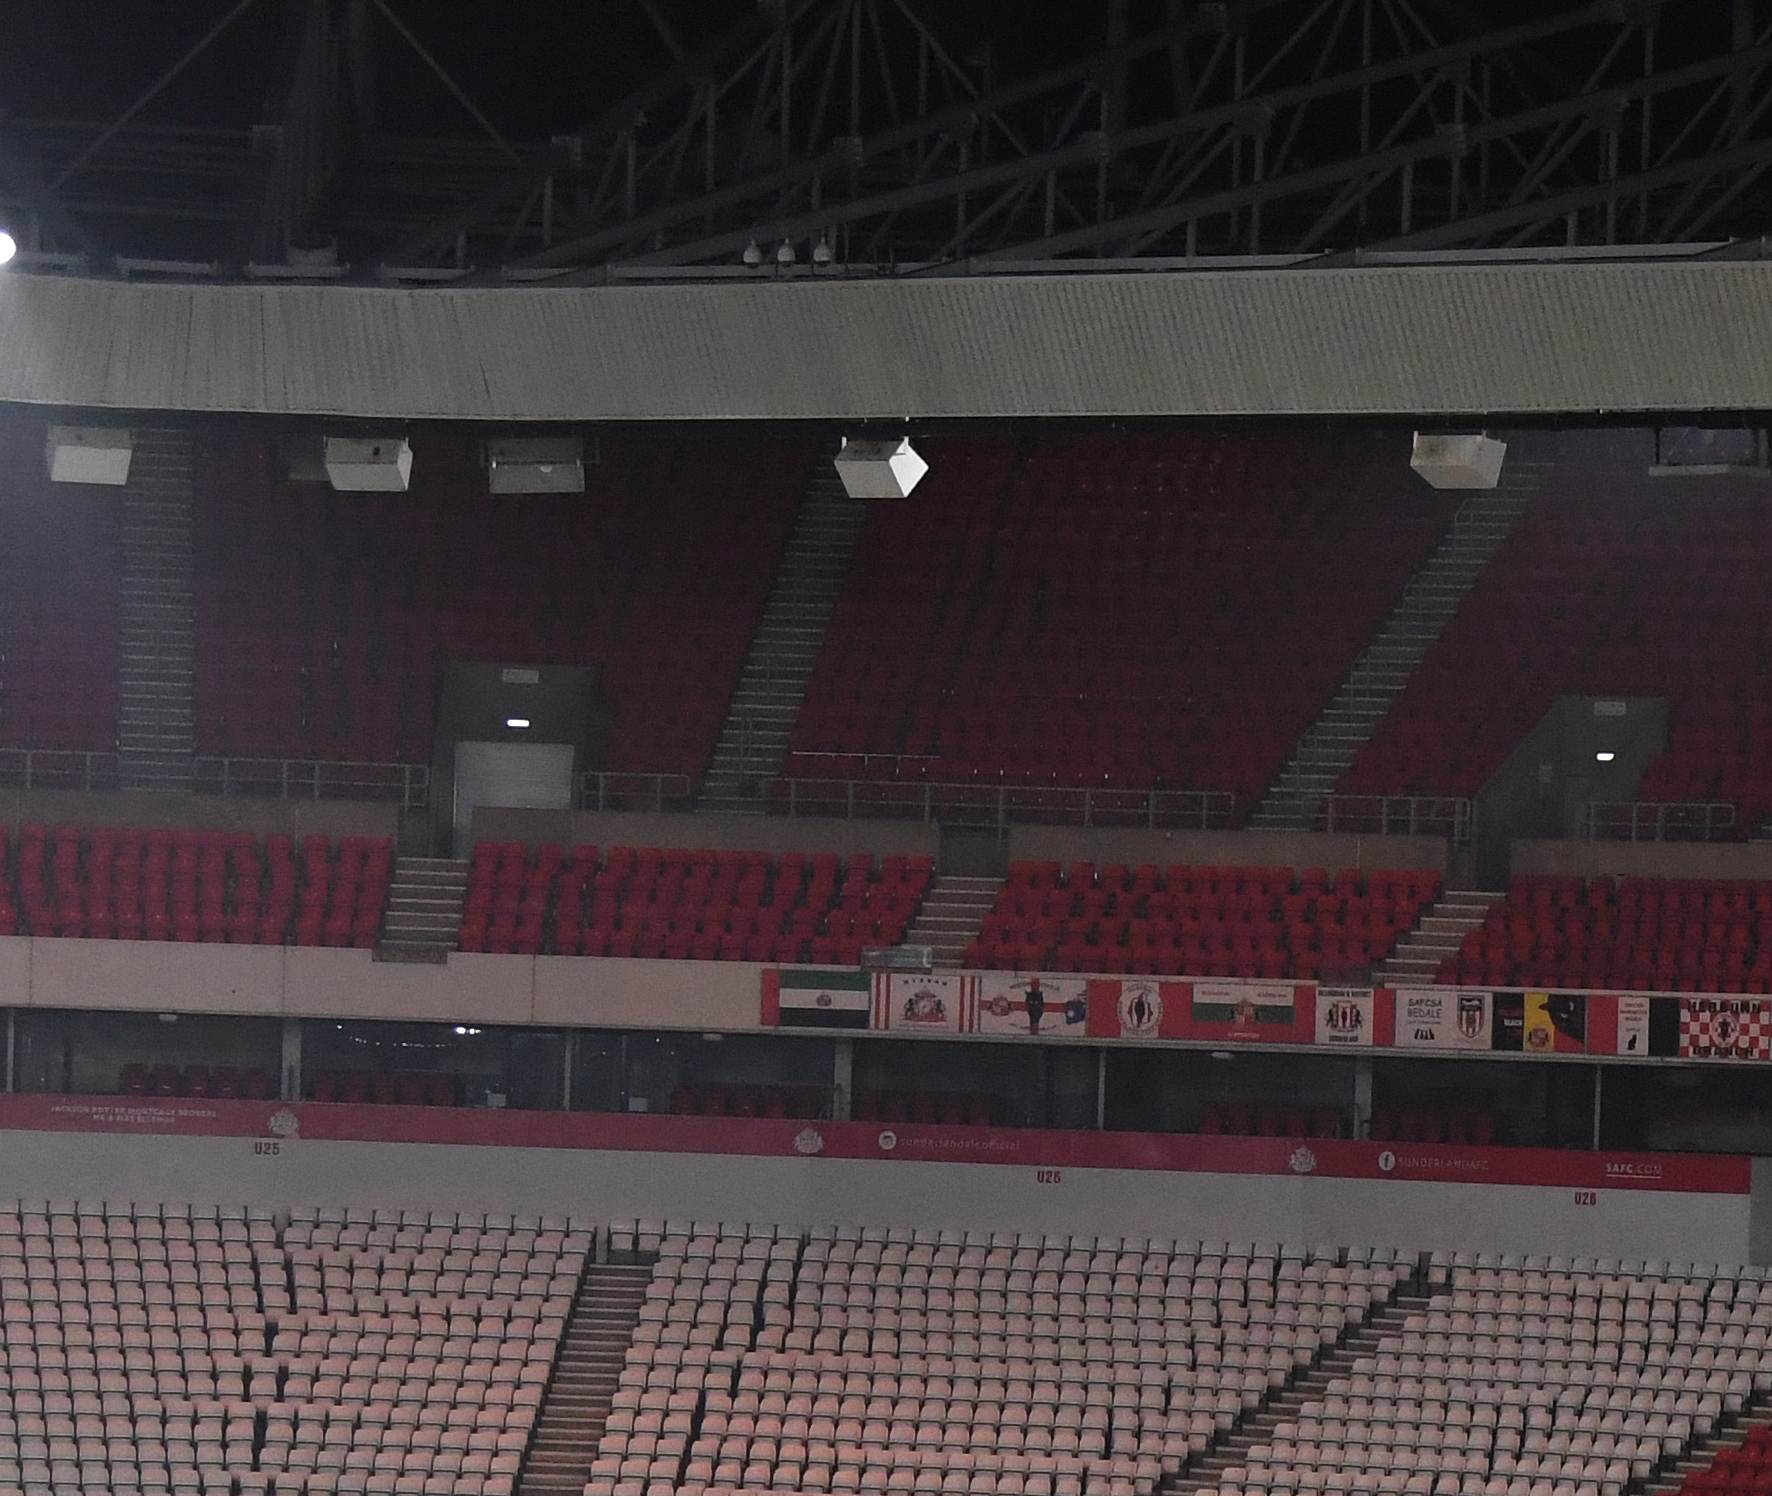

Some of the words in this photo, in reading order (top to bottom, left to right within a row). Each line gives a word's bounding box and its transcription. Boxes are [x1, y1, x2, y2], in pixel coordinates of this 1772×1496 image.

[255, 1142, 280, 1155] U25
[1605, 1162, 1663, 1174] SAFC.COM
[1037, 1170, 1061, 1184] U26
[1574, 1192, 1597, 1205] U26
